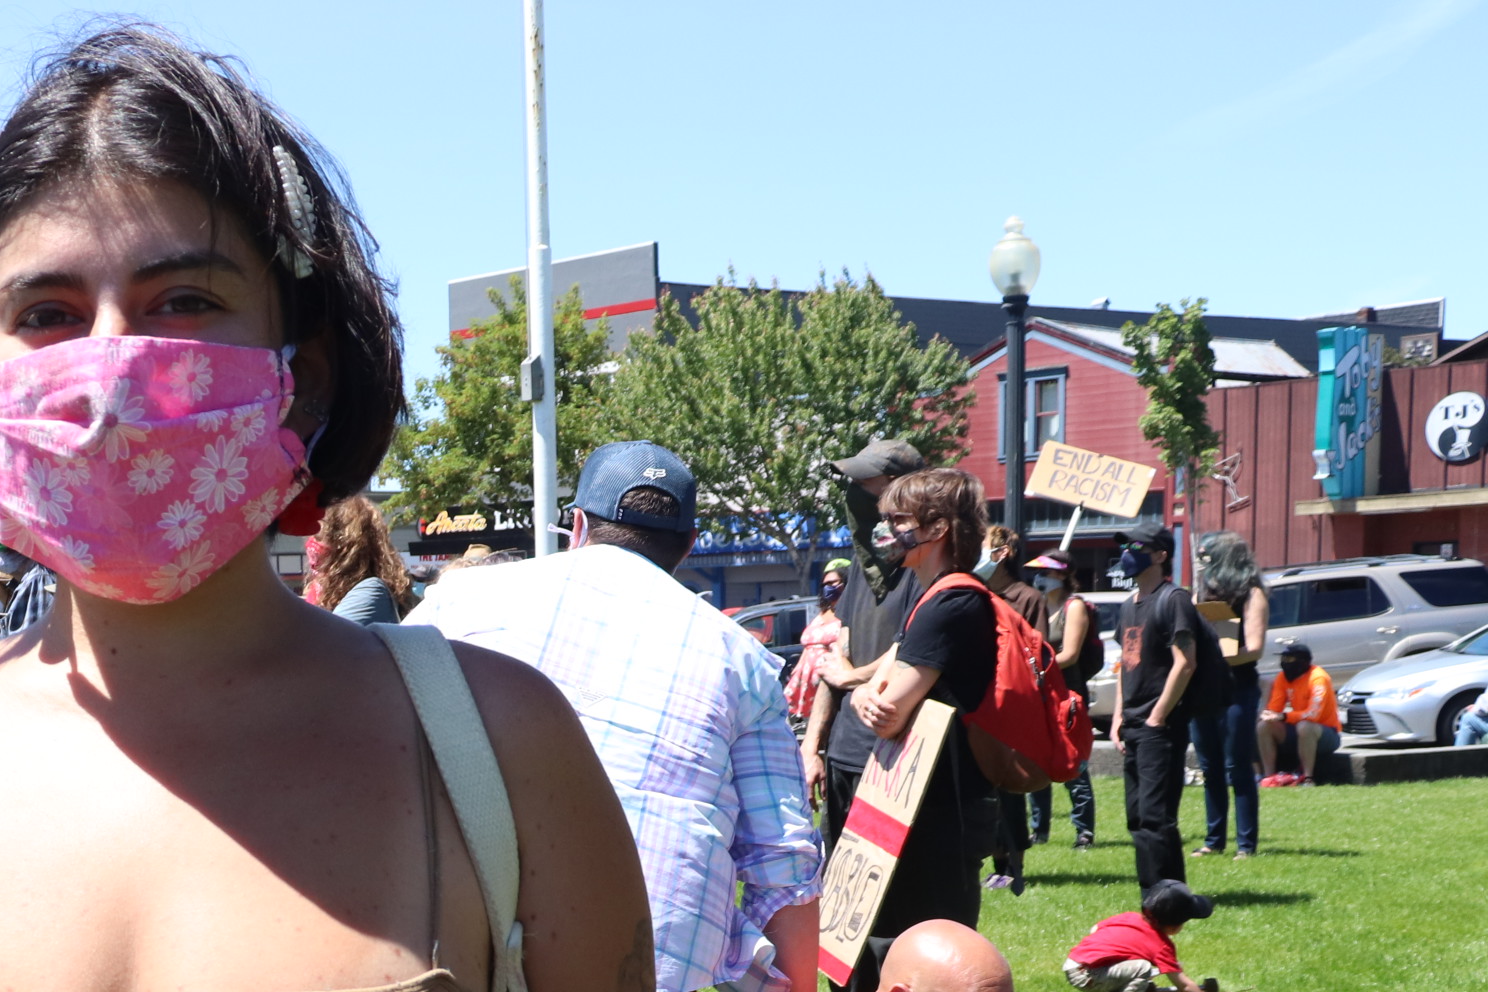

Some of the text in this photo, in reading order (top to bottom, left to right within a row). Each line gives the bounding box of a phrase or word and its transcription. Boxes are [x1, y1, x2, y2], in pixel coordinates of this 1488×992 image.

[1335, 335, 1382, 398] Toby
[1052, 448, 1138, 486] END ALL
[1048, 469, 1133, 508] RACISM
